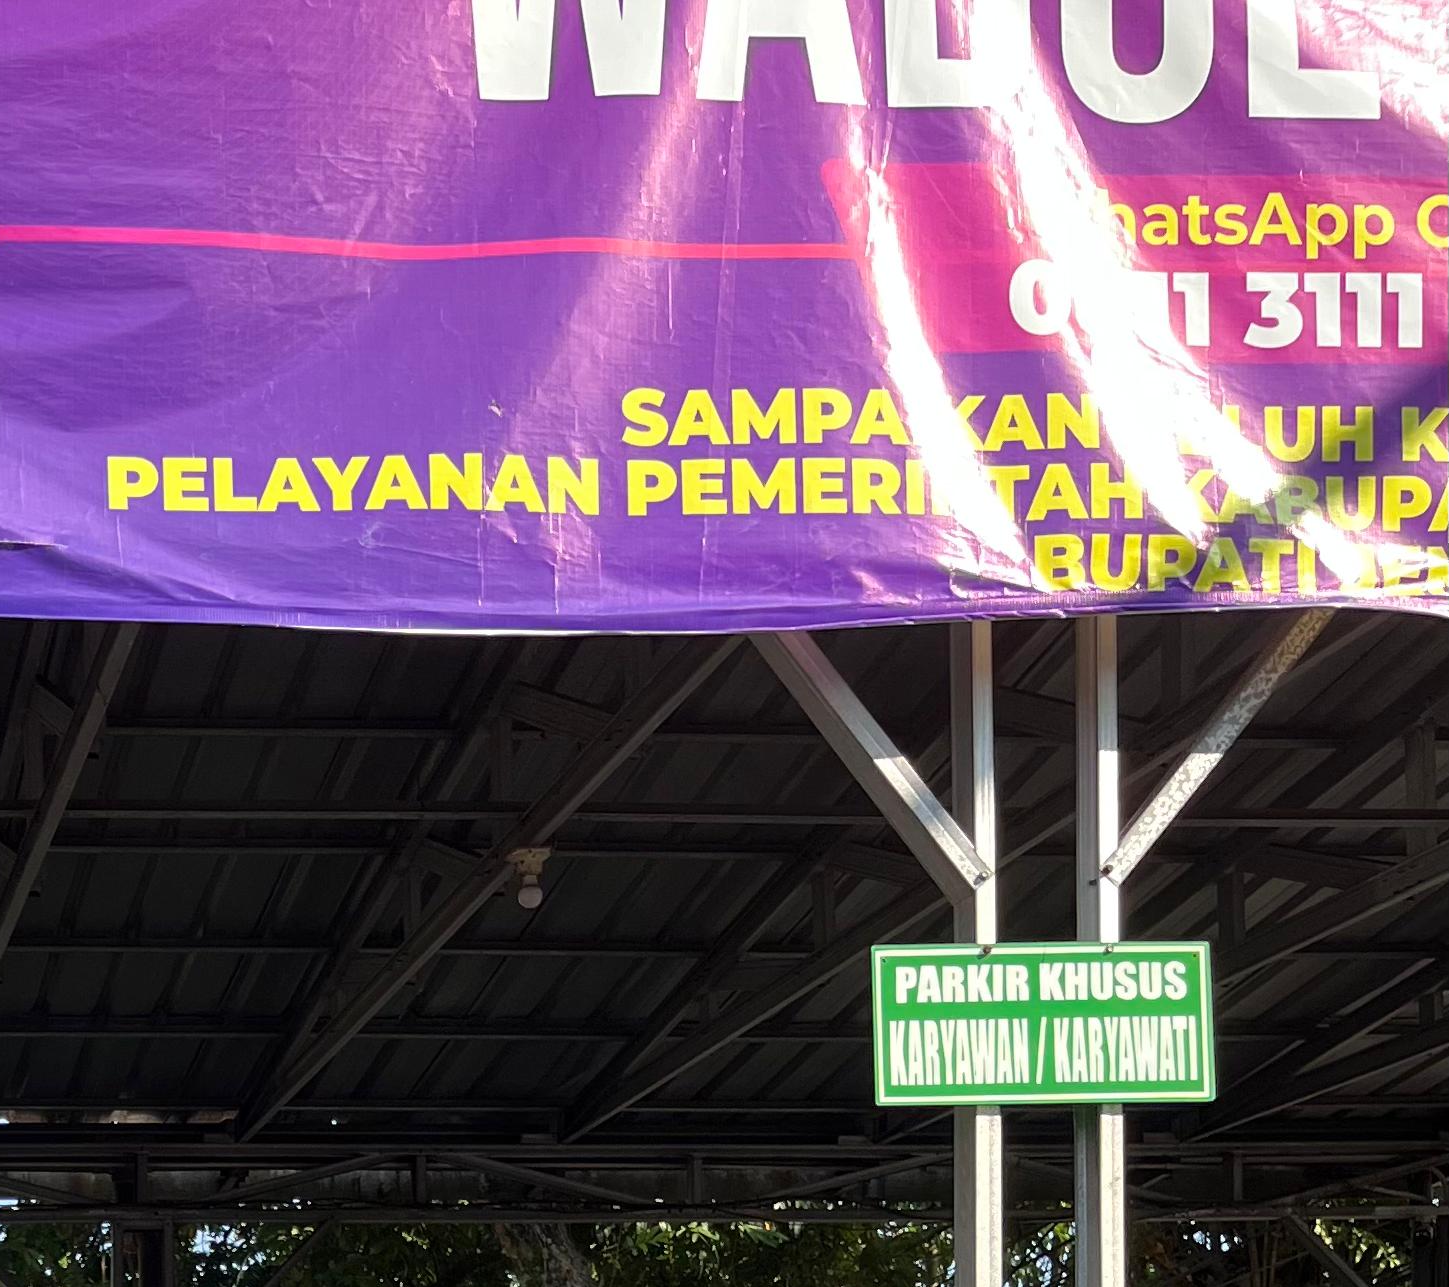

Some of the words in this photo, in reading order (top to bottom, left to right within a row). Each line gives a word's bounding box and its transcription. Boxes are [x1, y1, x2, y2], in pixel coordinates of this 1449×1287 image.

[1088, 188, 1395, 259] hatsApp
[1243, 271, 1424, 350] 3111
[621, 386, 1100, 451] SAMPAKAN
[106, 452, 600, 516] PELAYANAN
[626, 456, 1144, 521] PEMERITAH
[895, 964, 1030, 1004] PARKIR
[1039, 960, 1188, 1002] KHUSUS
[889, 1018, 1031, 1087] KARYAWAN
[1053, 1014, 1199, 1083] KARYAWATI
